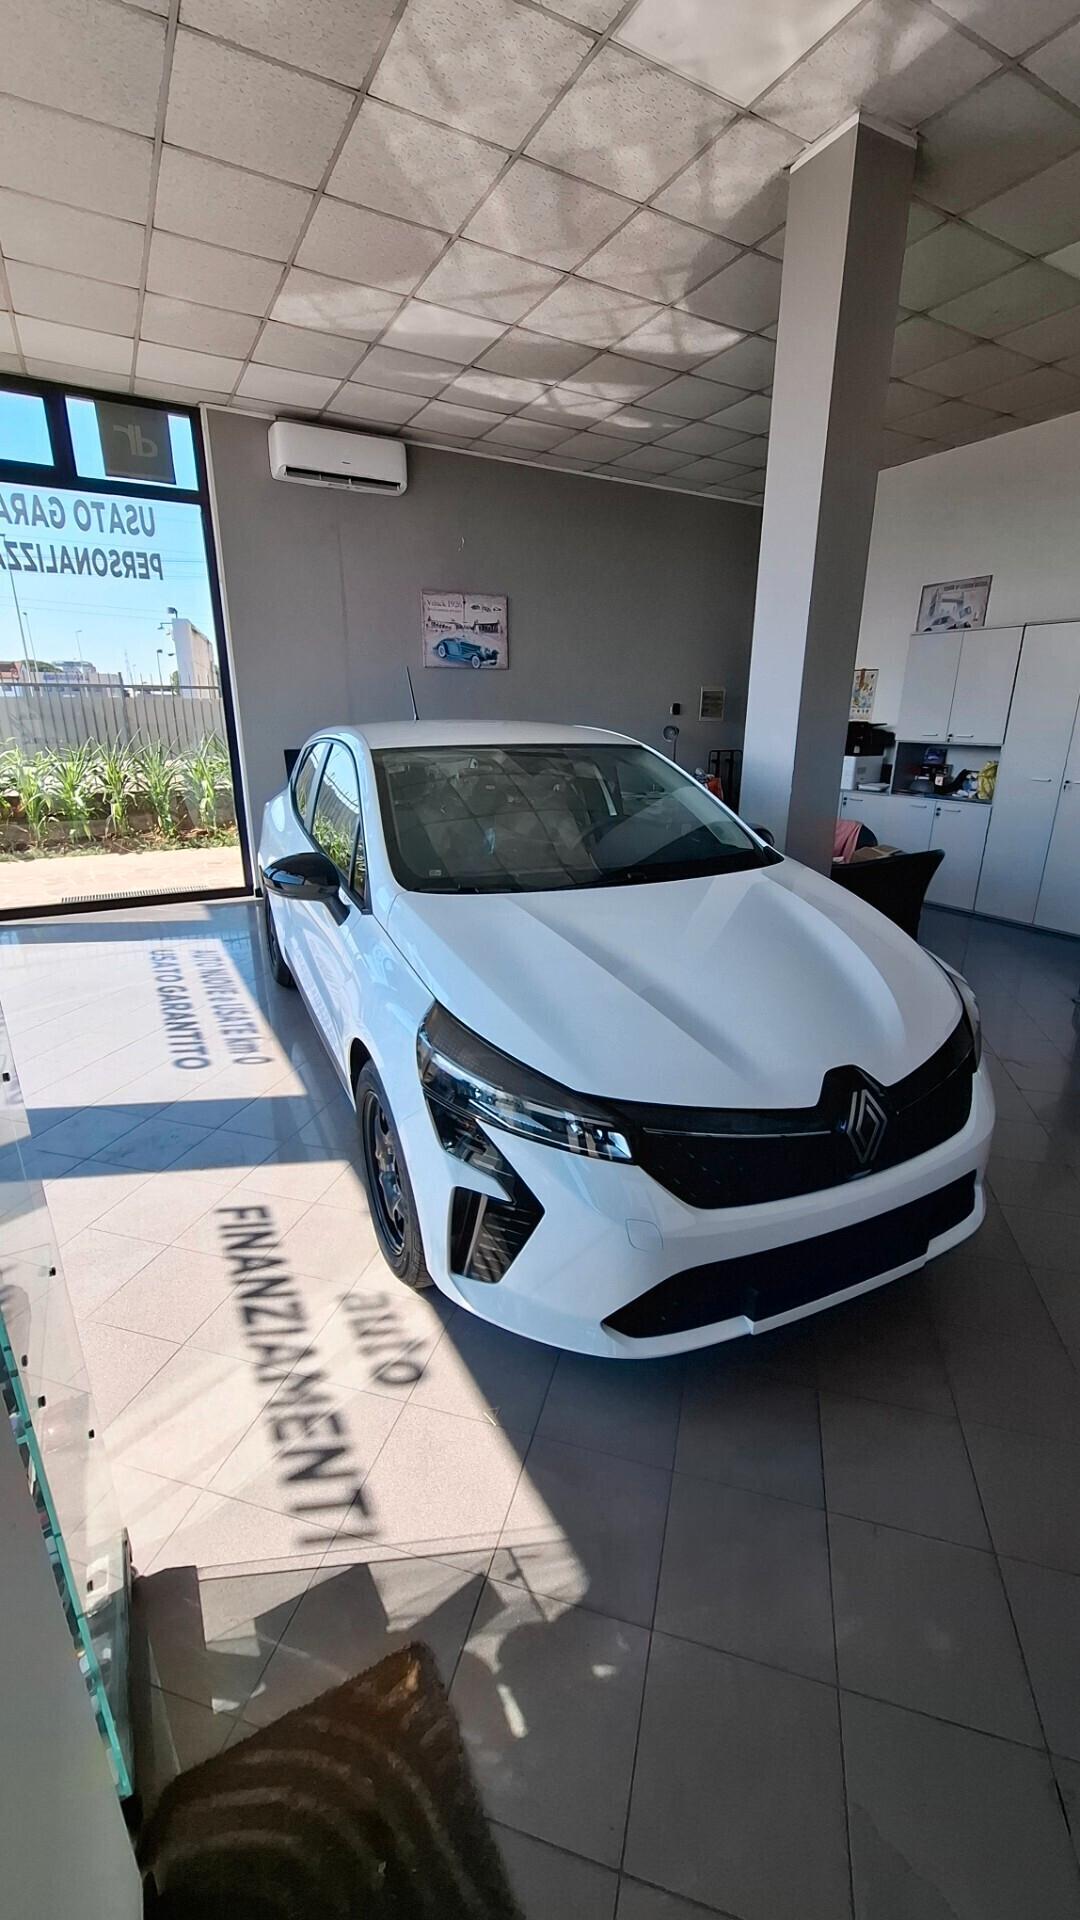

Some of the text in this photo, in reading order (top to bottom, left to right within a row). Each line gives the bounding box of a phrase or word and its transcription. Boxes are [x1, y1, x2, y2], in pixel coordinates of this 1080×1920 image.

[150, 949, 211, 1069] USATO GARANTITO
[212, 1003, 257, 1035] USATE
[215, 1205, 381, 1545] FINANZIAMENTI
